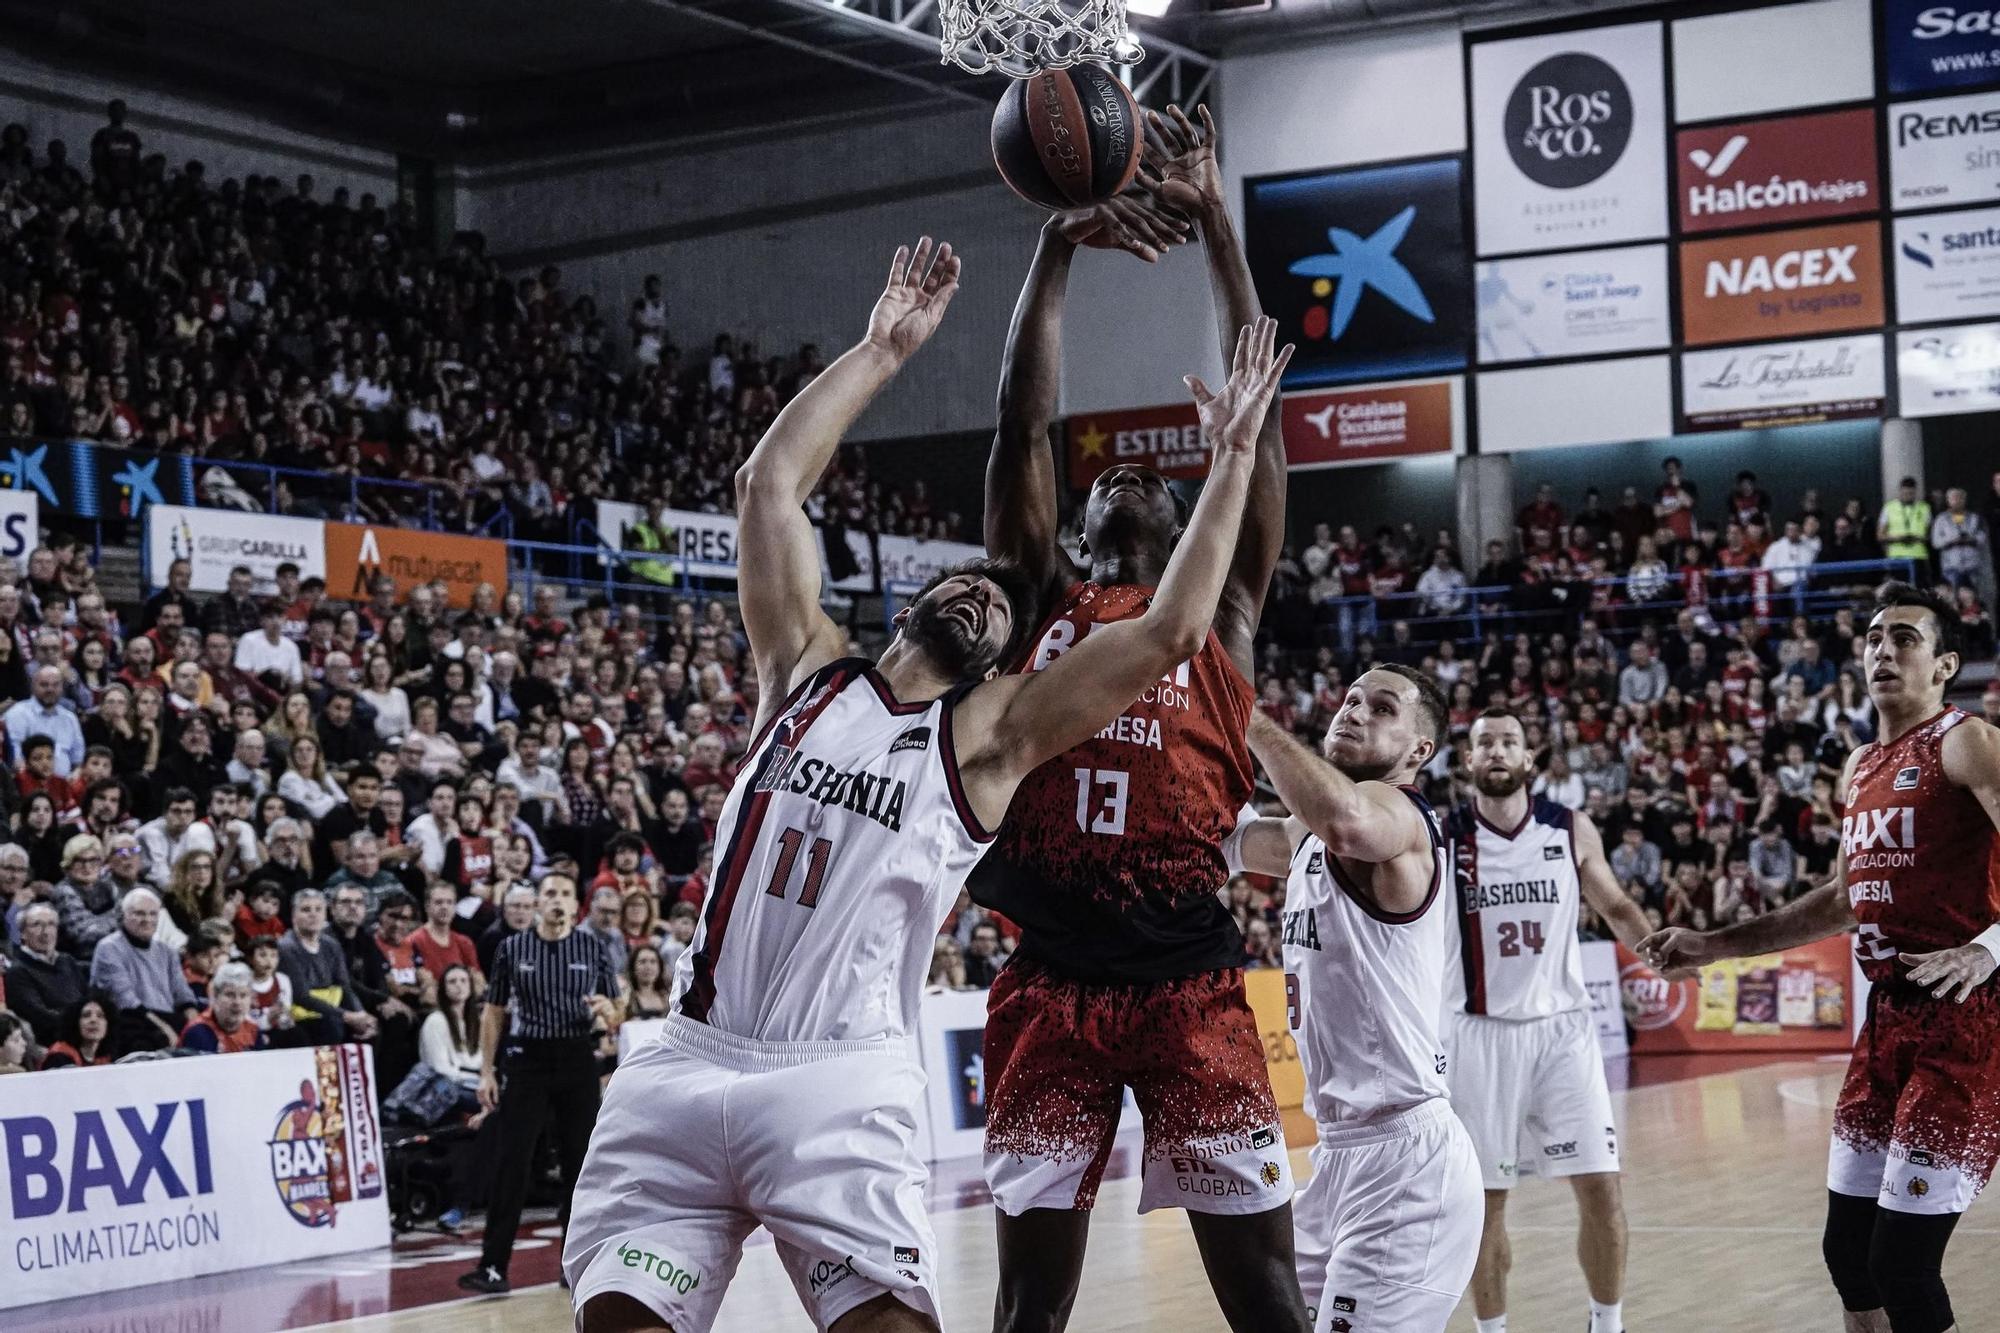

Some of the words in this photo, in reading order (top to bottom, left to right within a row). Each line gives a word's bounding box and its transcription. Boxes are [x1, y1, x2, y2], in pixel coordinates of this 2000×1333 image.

[1529, 84, 1612, 129] Ros
[1704, 245, 1859, 298] NACEX
[1074, 767, 1130, 836] 13
[765, 826, 834, 909] 11
[1496, 919, 1546, 958] 24
[1, 1098, 214, 1220] BAXI
[1254, 1137, 1271, 1149] acb
[1177, 1176, 1252, 1196] GLOBAL
[16, 1204, 221, 1272] CLIMATIZACIÓN
[895, 1251, 914, 1263] acb
[1334, 1301, 1351, 1312] acb
